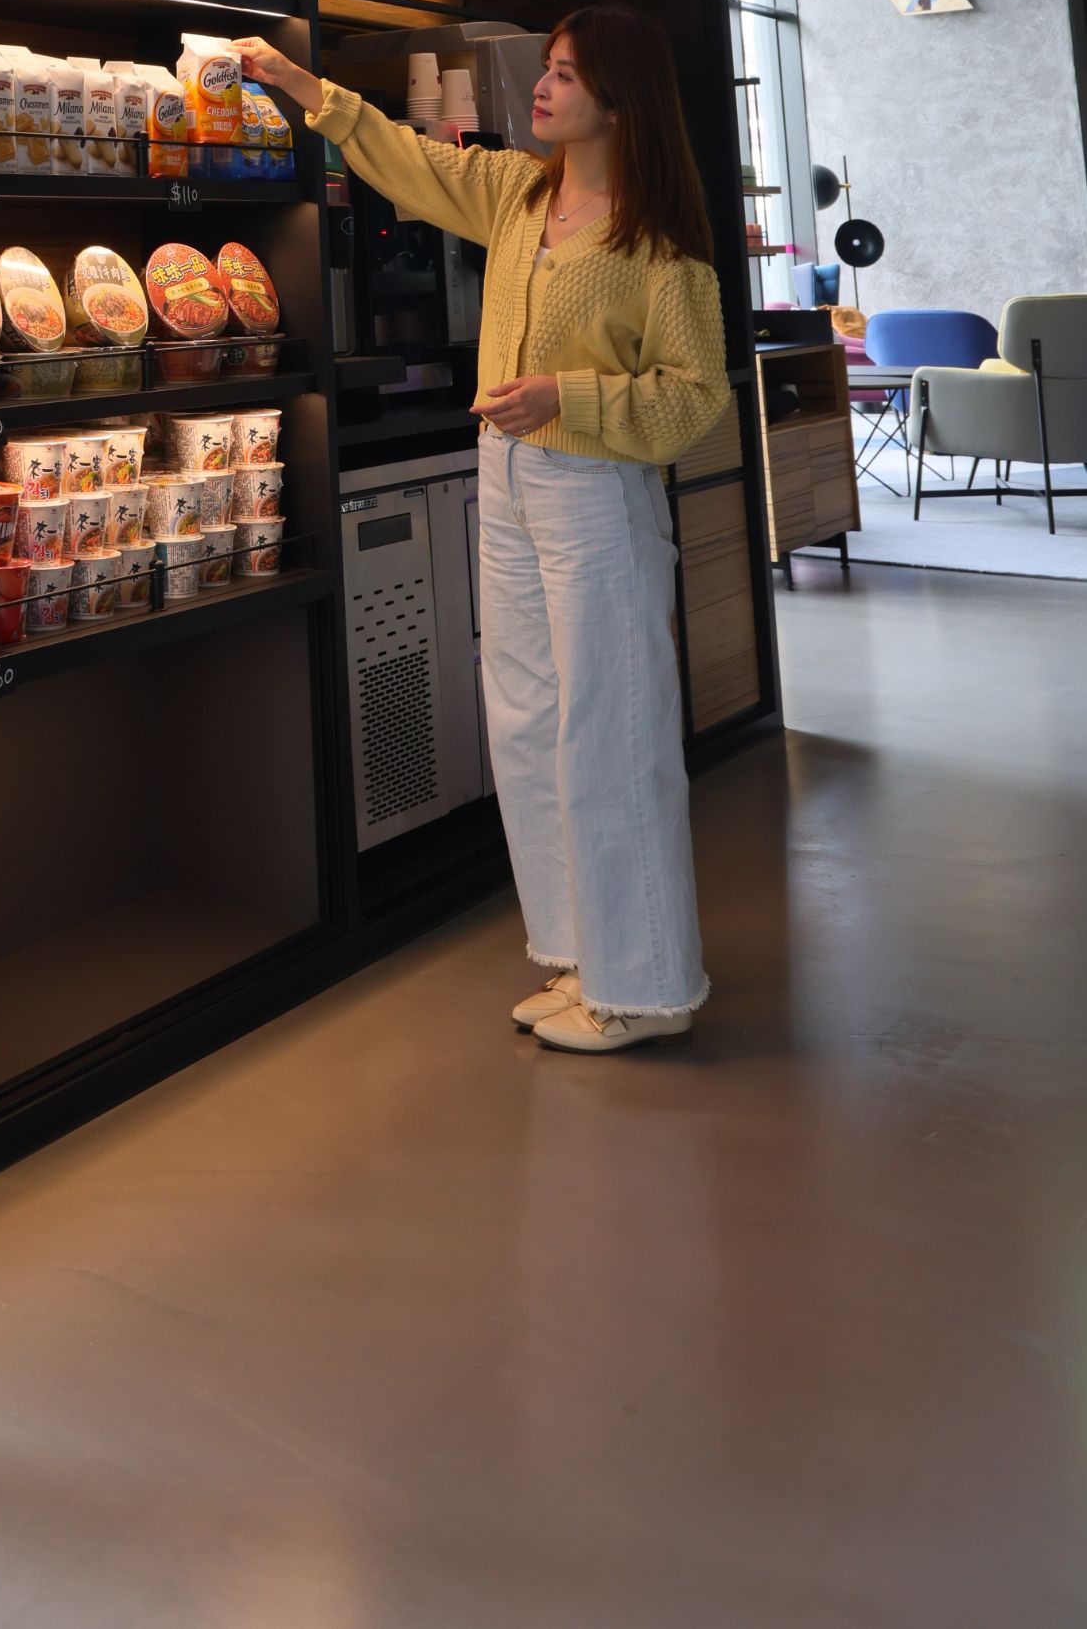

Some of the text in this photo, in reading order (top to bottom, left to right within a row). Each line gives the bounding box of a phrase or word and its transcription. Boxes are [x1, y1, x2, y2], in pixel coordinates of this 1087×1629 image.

[203, 67, 239, 89] Goldfish
[19, 97, 50, 110] Chessmen
[54, 101, 84, 116] Milano
[170, 181, 198, 206] $110
[151, 255, 208, 285] 味味一品
